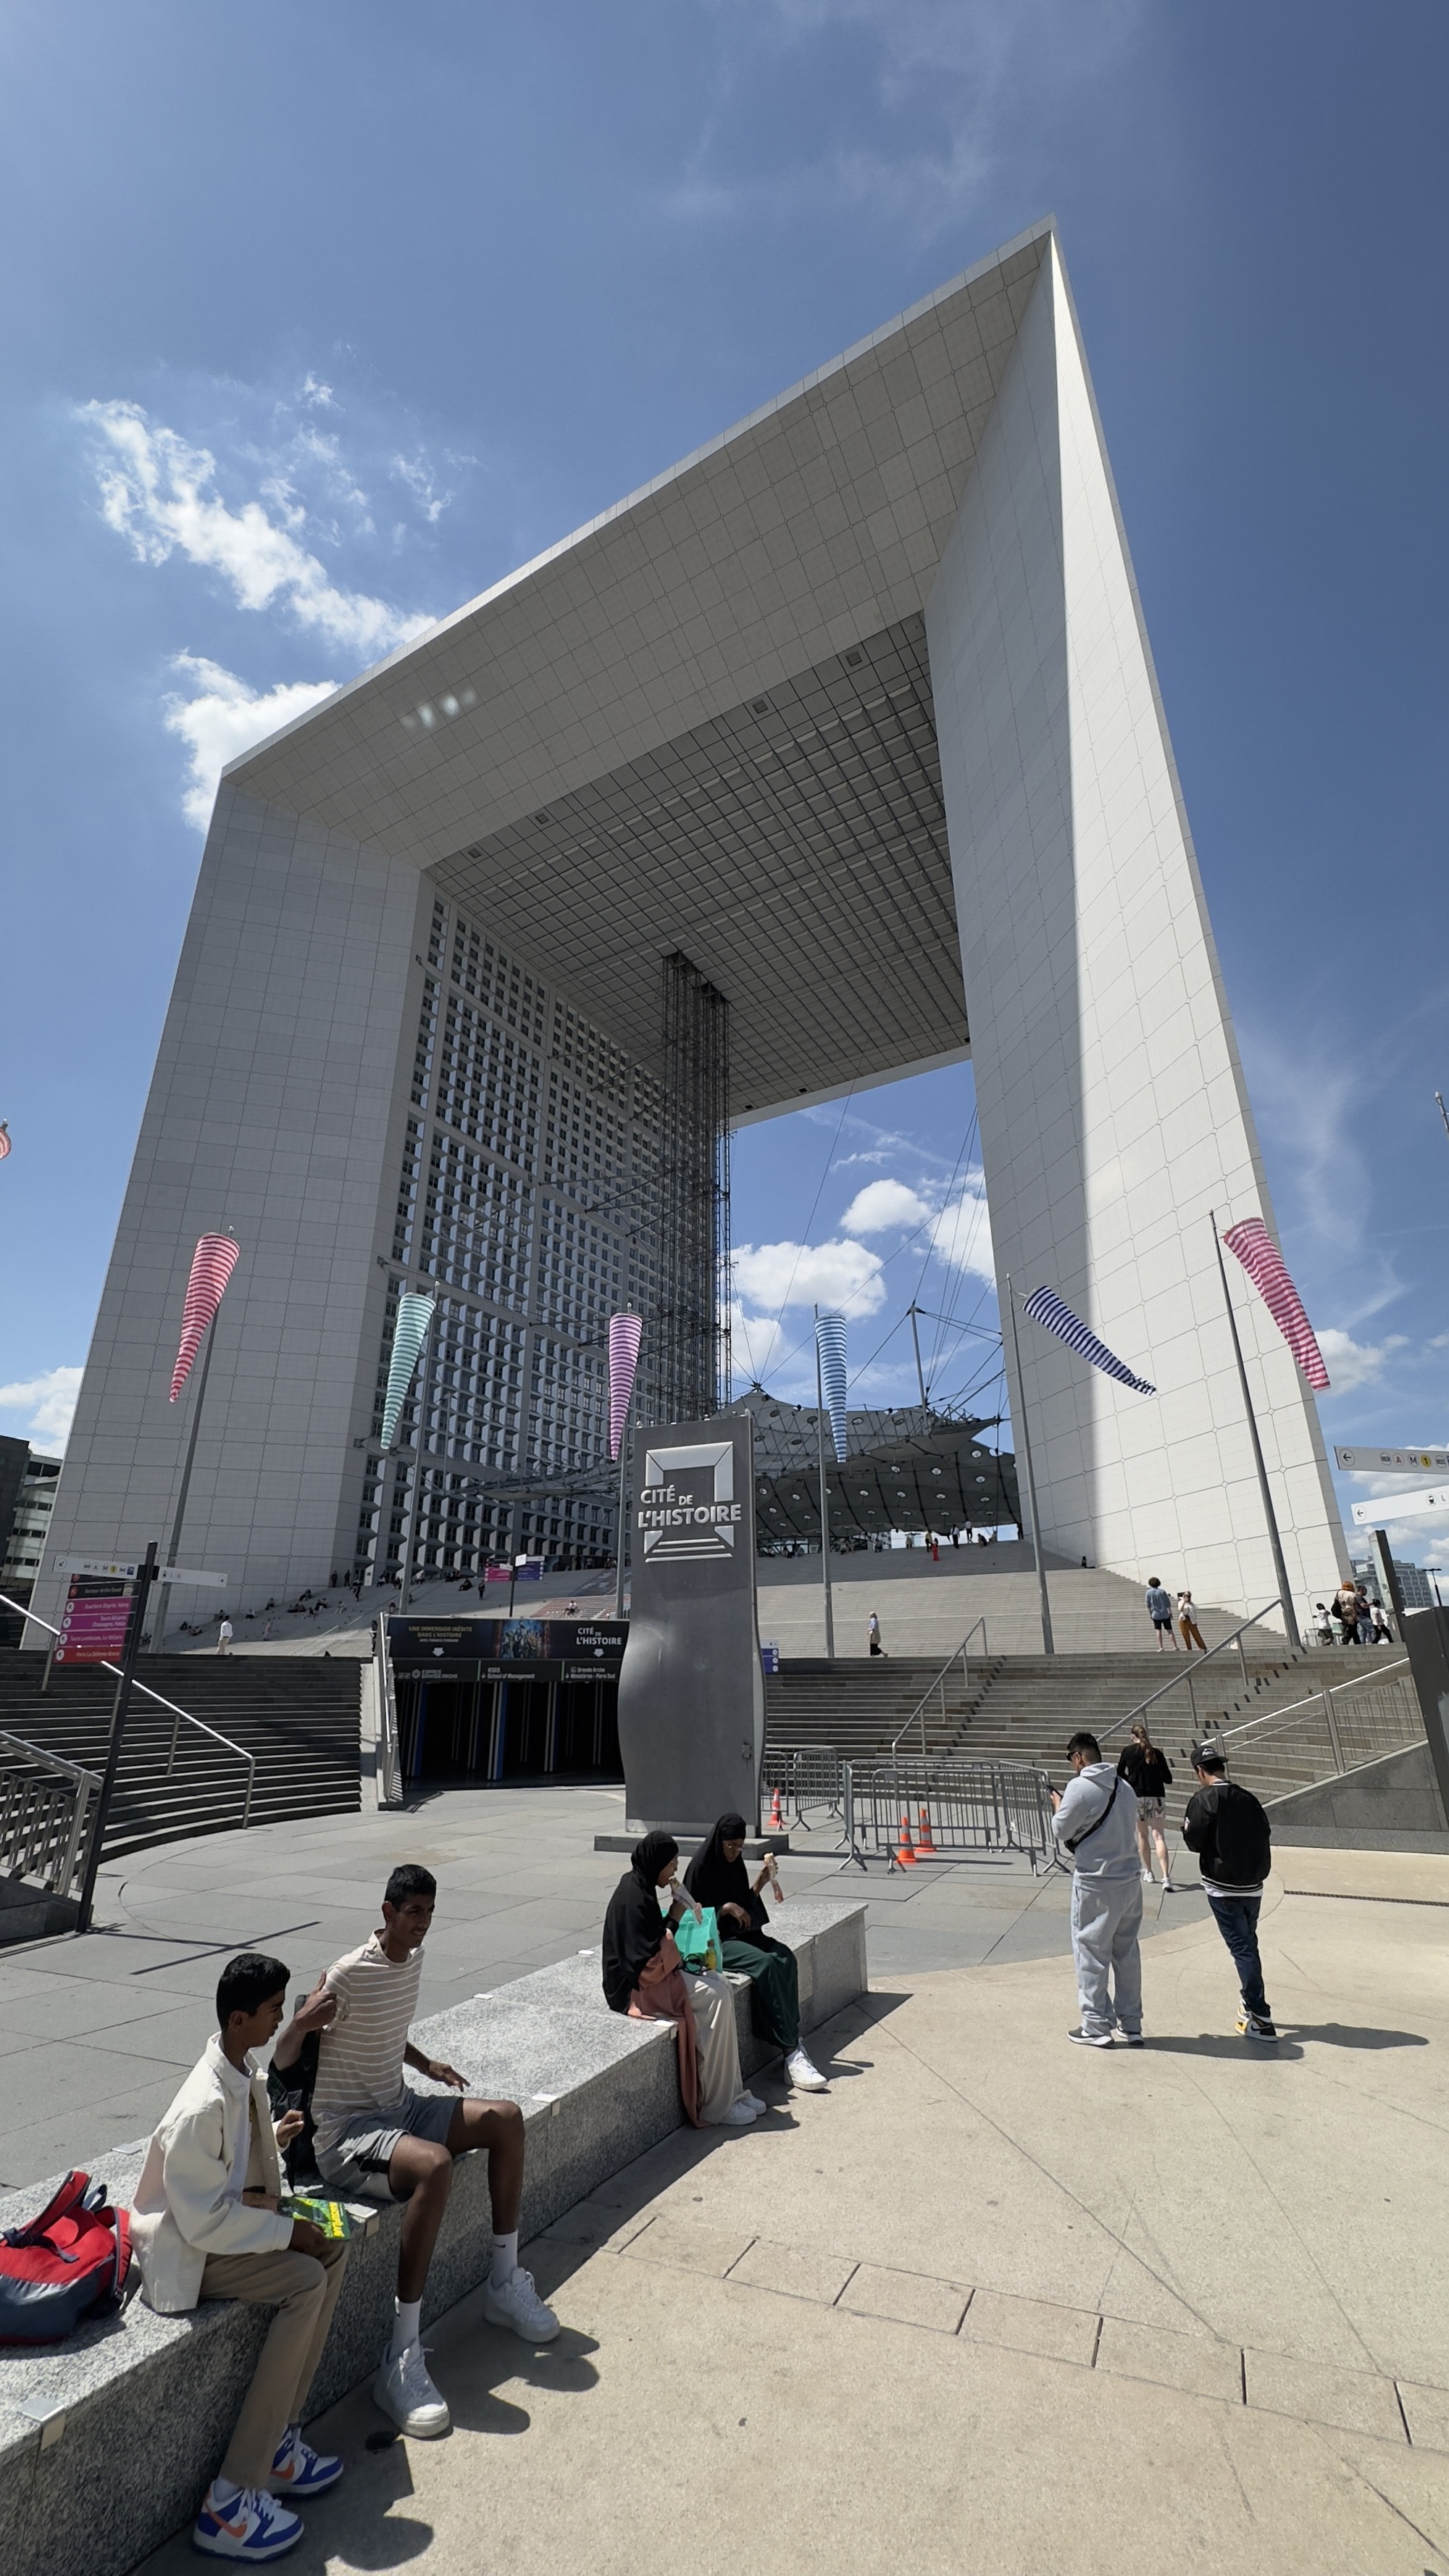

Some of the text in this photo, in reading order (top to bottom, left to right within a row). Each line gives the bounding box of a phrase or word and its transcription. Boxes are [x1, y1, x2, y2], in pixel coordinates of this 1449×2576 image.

[640, 1485, 693, 1506] CITÉ DE
[638, 1504, 742, 1528] L'HISTOIRE
[577, 1626, 594, 1635] CITÉ
